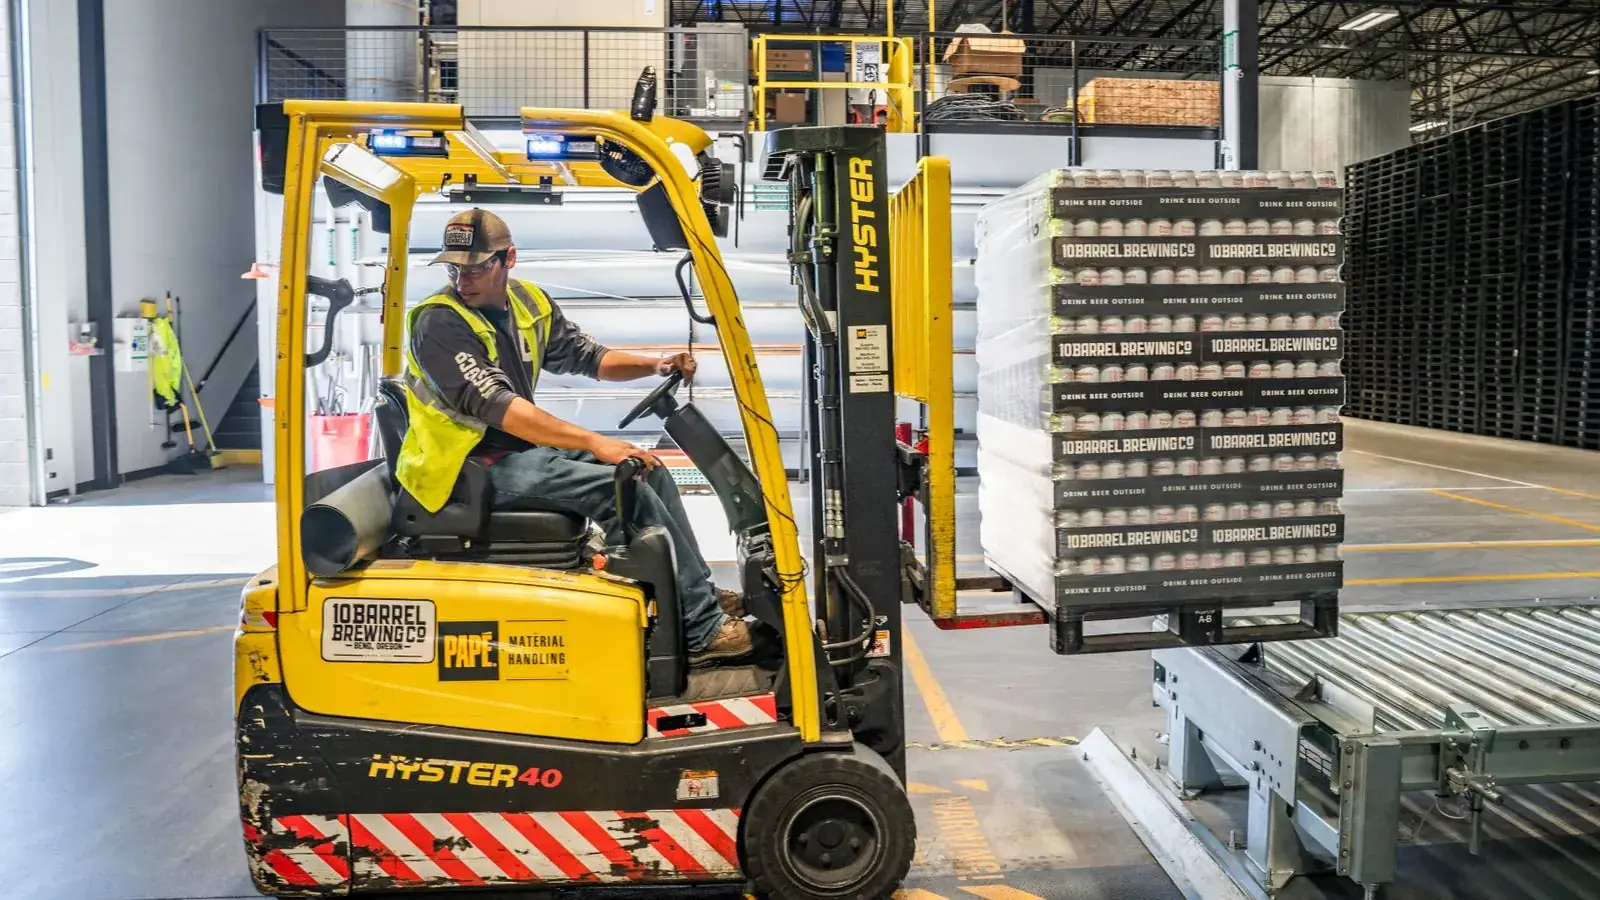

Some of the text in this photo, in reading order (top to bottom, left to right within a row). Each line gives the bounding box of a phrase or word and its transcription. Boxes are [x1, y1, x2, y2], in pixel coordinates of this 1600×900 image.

[849, 157, 880, 293] HYSTER
[1260, 293, 1283, 301] DRINK
[1306, 292, 1336, 300] OUTSIDE
[1061, 391, 1143, 401] DRINK BEER OUTSIDE
[1164, 391, 1187, 399] DRINK
[1212, 390, 1243, 398] OUTSIDE
[1262, 389, 1284, 397] DRINK
[1211, 482, 1241, 490] OUTSIDE
[1260, 484, 1283, 492] DRINK
[1307, 481, 1337, 490] OUTSIDE
[1064, 488, 1145, 498] DRINK BEER OUTSIDE
[1163, 576, 1242, 587] DRINK BEER OUTSIDE
[1260, 574, 1283, 582] DRINK
[1305, 571, 1335, 579] OUTSIDE
[1065, 587, 1089, 595] DRINK
[1114, 584, 1146, 593] OUTSIDE
[508, 635, 565, 648] MATERIAL
[376, 643, 404, 651] OREGON
[508, 653, 566, 666] HANDLING
